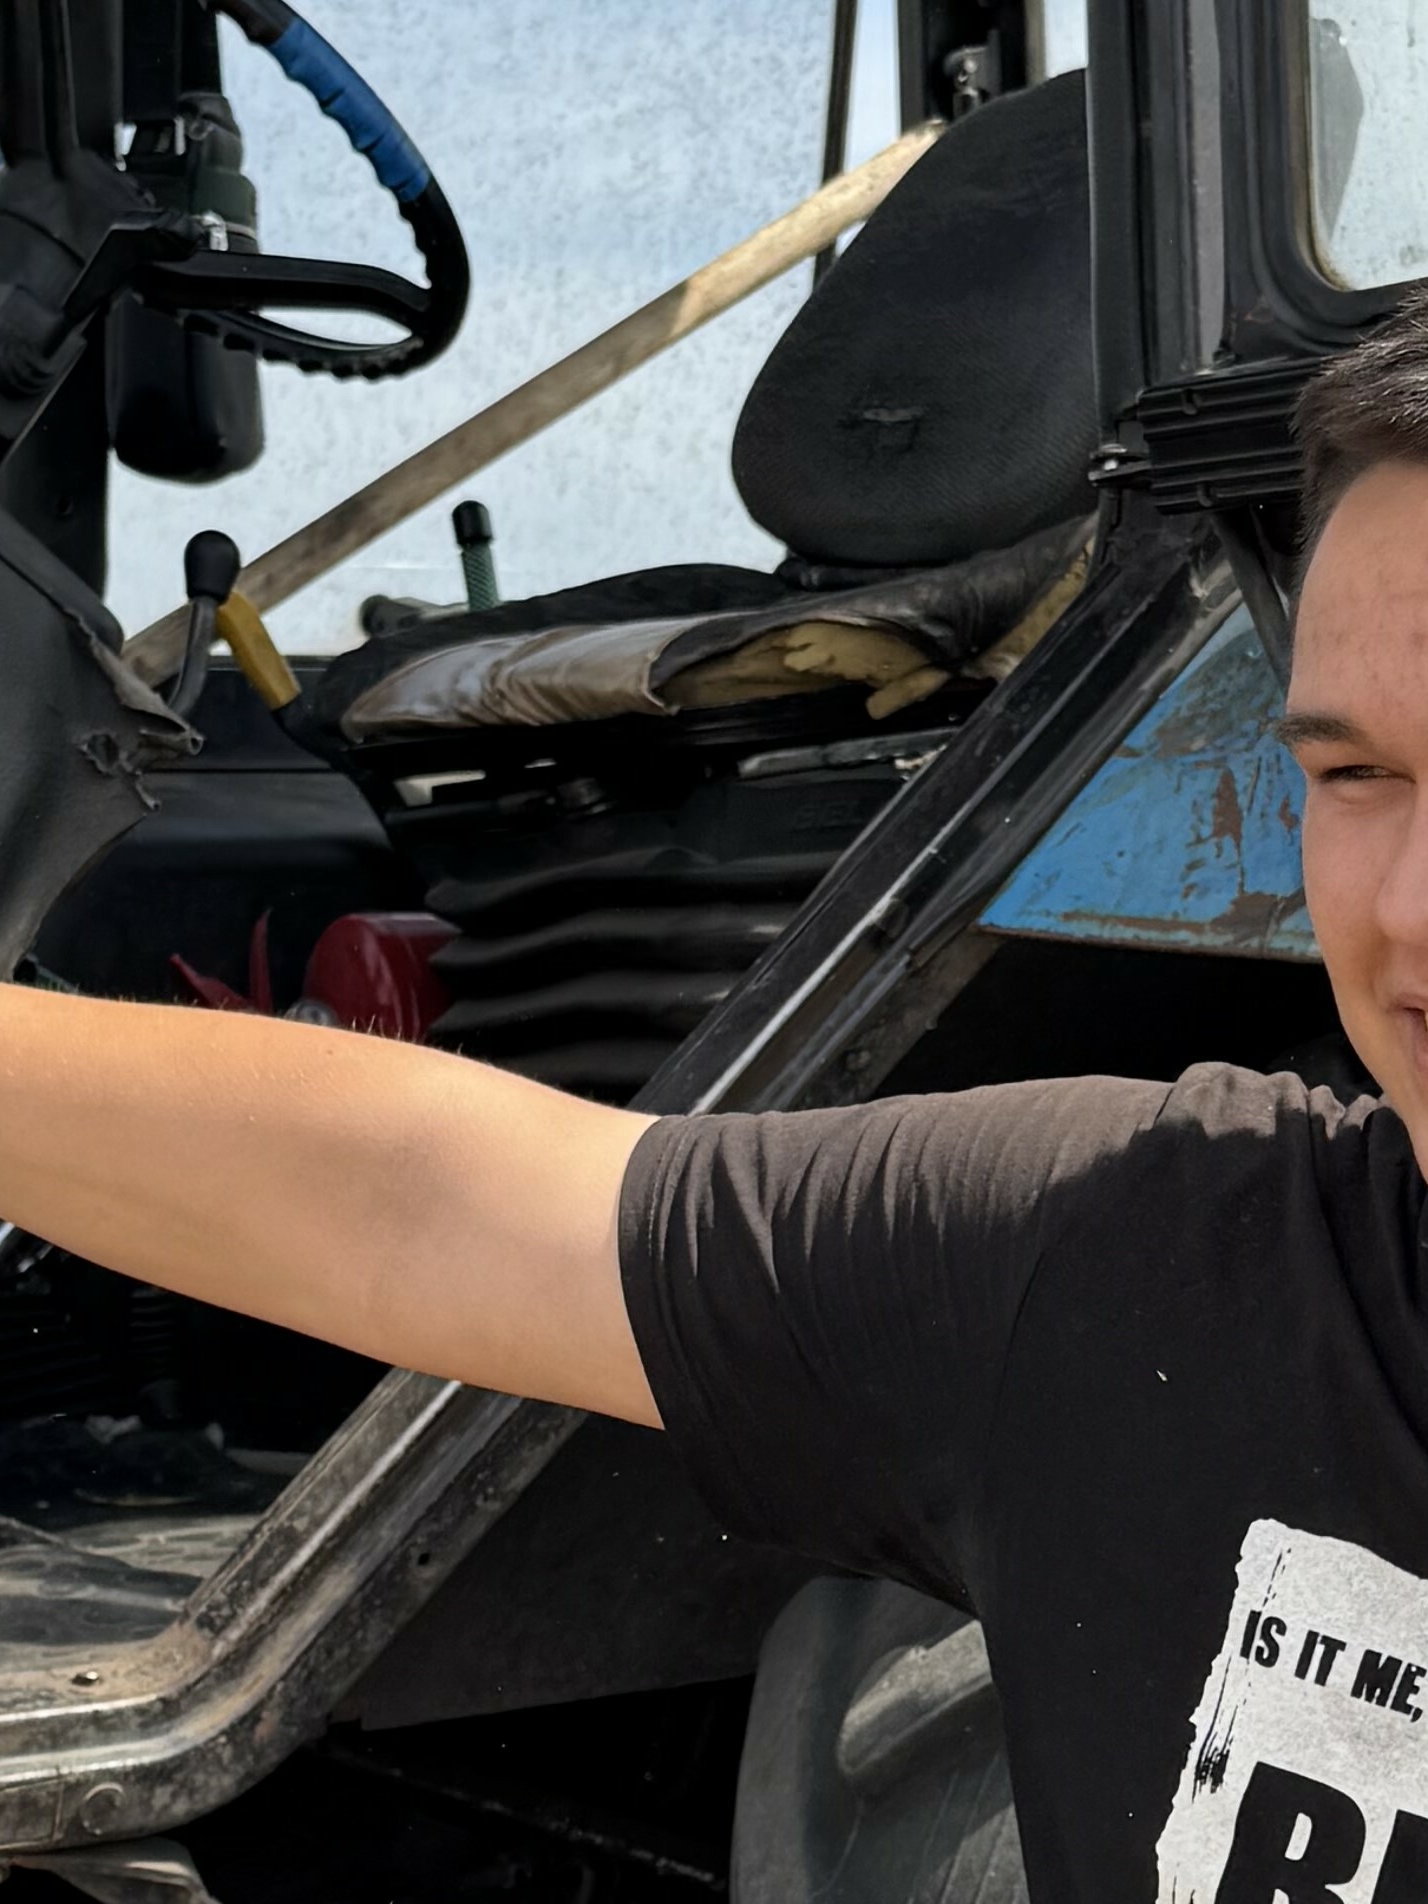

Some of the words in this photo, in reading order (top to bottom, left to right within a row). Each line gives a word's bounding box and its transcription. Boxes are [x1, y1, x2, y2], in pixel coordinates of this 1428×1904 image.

[1239, 1609, 1288, 1668] IS
[1294, 1629, 1347, 1687] IT
[1350, 1649, 1428, 1723] ME,
